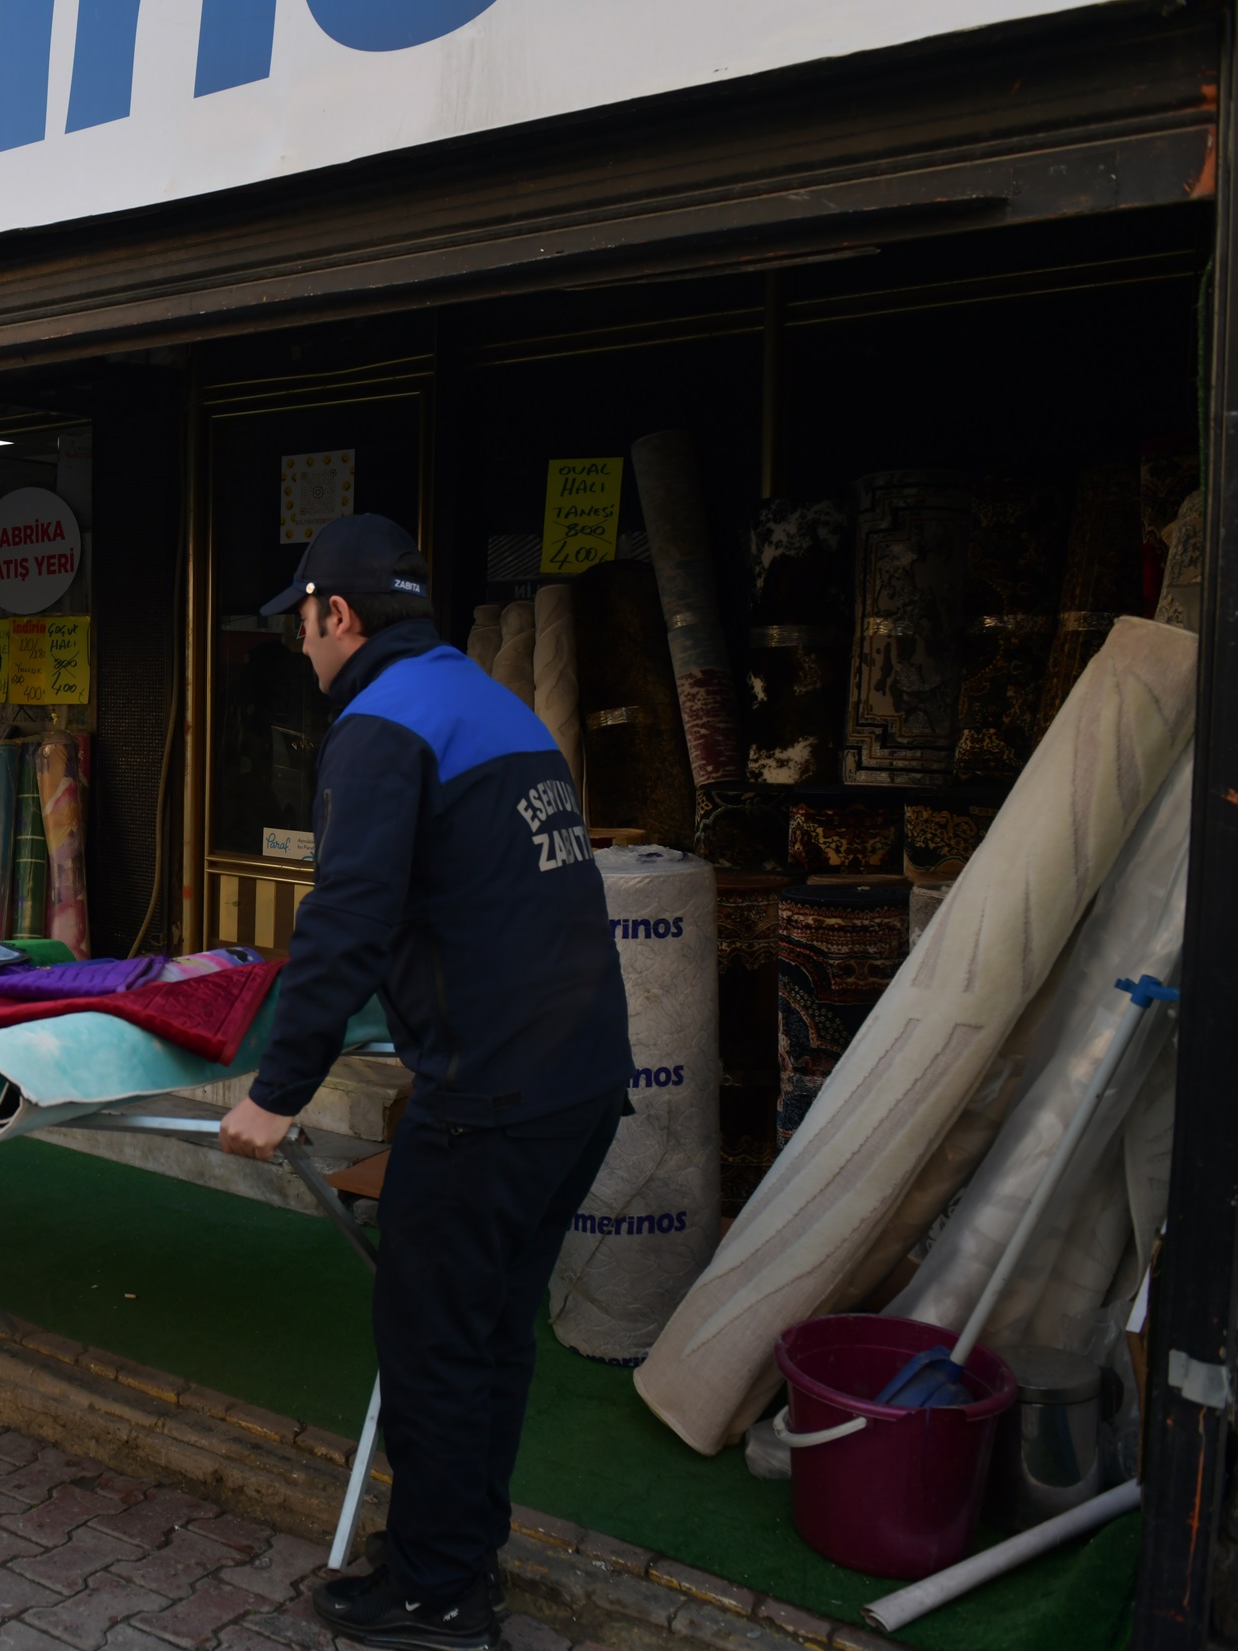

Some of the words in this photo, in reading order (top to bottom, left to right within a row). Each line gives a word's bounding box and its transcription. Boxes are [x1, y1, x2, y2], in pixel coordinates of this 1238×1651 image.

[560, 477, 605, 497] HALI
[565, 523, 606, 538] 800
[34, 547, 75, 576] YERİ
[394, 579, 421, 593] ZABITA
[50, 639, 77, 652] HALI
[574, 1211, 687, 1236] merinos
